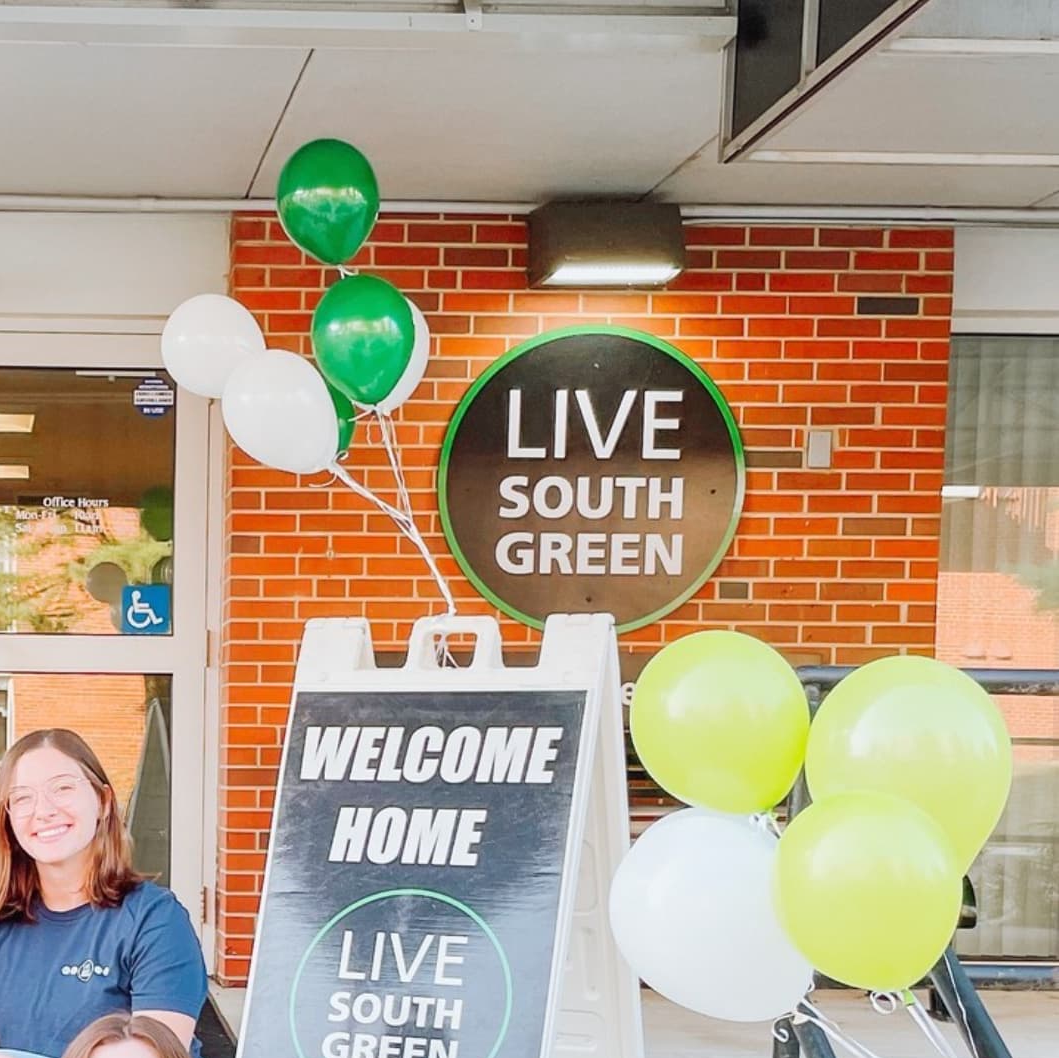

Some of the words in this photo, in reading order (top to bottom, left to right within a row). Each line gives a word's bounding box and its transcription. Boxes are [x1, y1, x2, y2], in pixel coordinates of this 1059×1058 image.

[507, 388, 684, 460] LIVE
[43, 497, 76, 508] Office
[77, 497, 109, 508] Hours
[498, 475, 685, 520] SOUTH
[495, 531, 685, 576] GREEN
[300, 726, 564, 784] WELCOME
[328, 806, 488, 867] HOME
[338, 930, 470, 987] LIVE
[327, 991, 464, 1031] SOUTH
